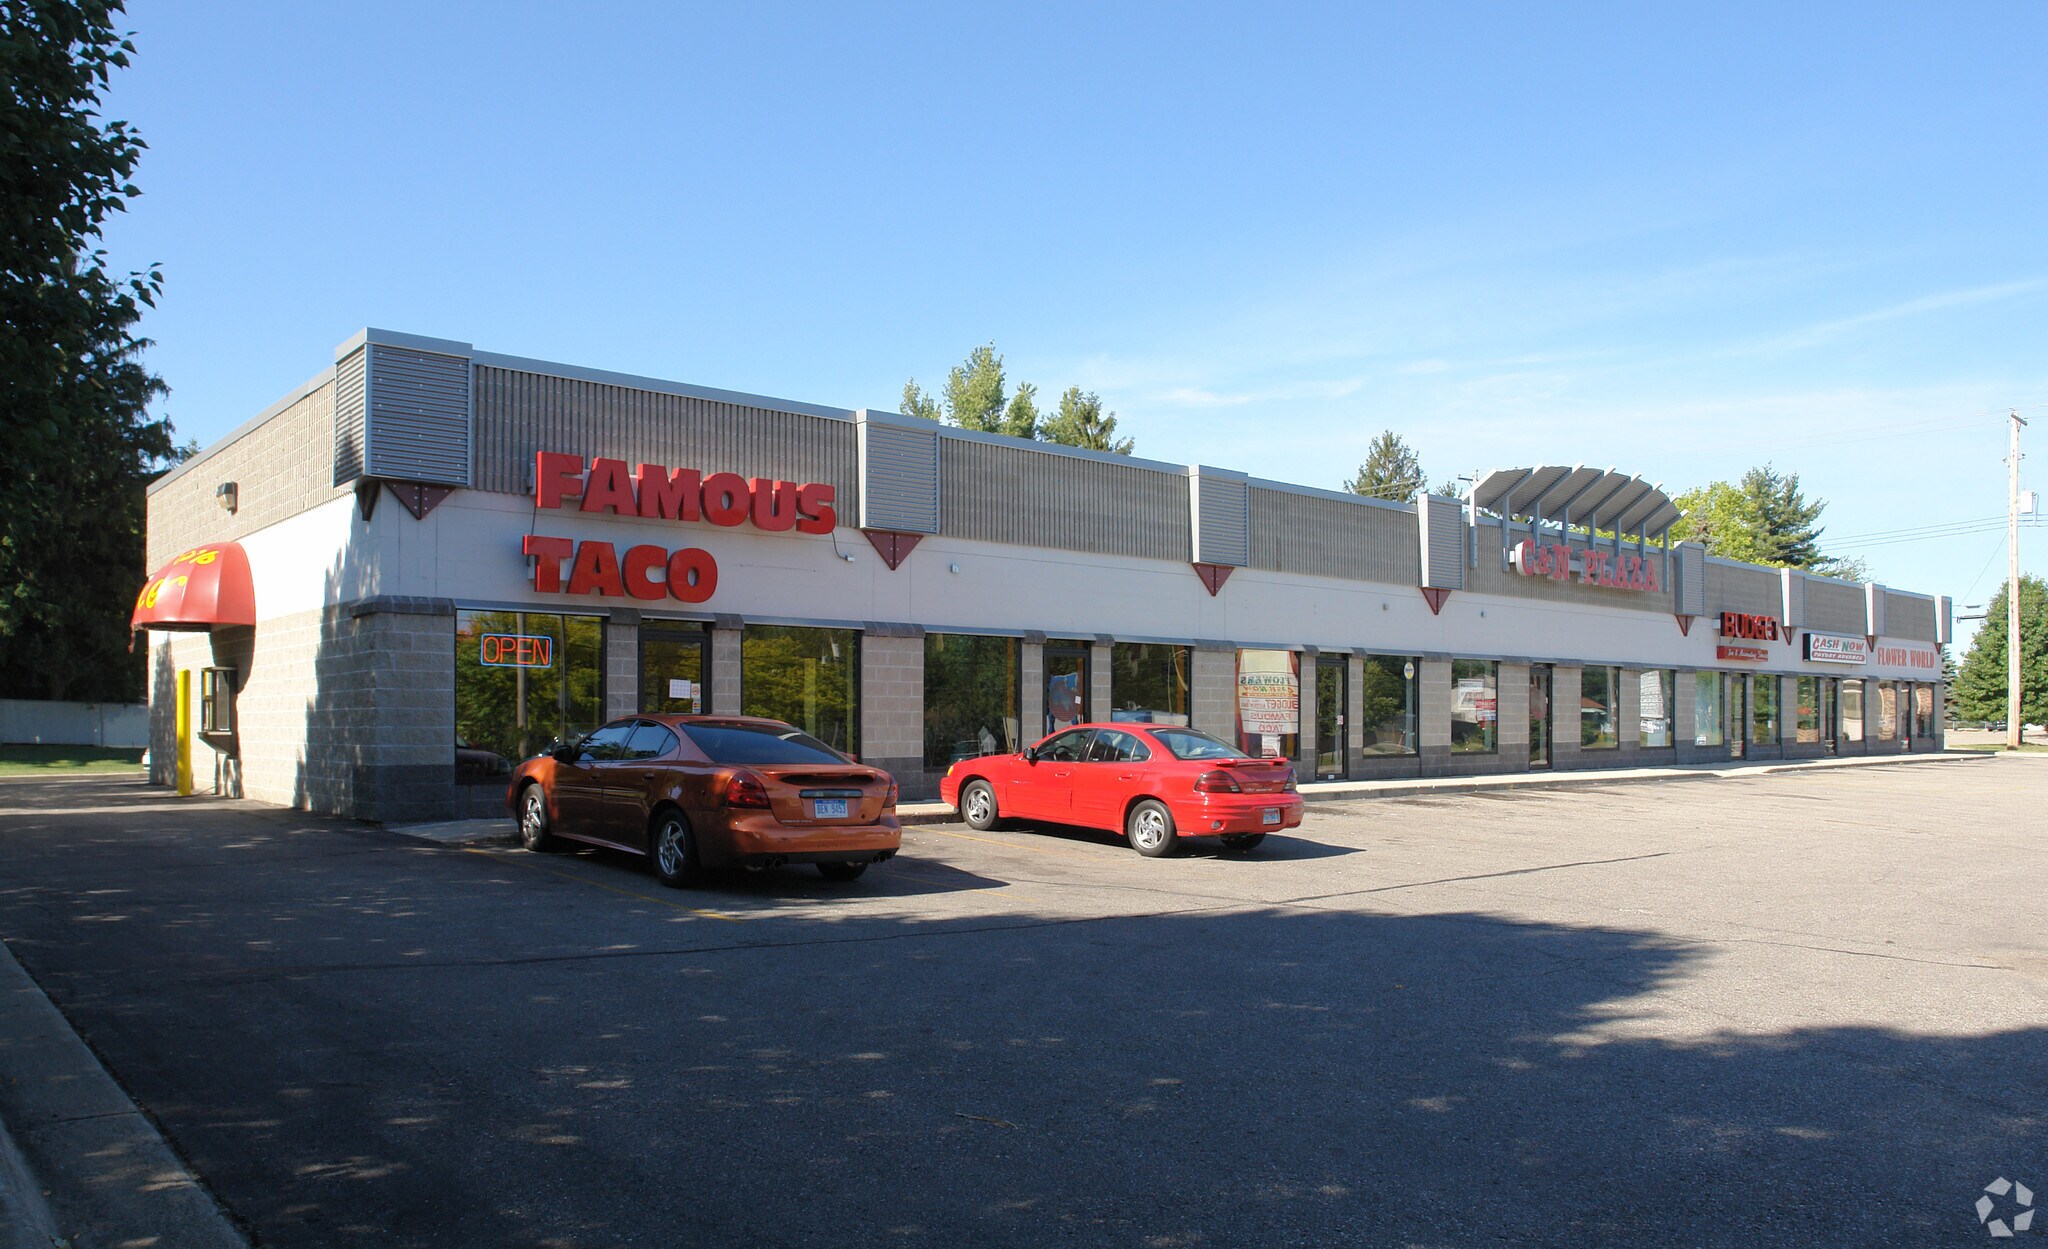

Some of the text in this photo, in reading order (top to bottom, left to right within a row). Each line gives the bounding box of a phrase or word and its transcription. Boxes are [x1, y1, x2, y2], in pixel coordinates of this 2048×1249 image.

[536, 451, 836, 535] FAMOUS
[522, 534, 718, 603] TACO
[1583, 549, 1659, 592] PLAZA
[483, 636, 550, 666] OPEN
[1812, 637, 1865, 651] CASH NOW
[1877, 647, 1935, 669] FLOWER WORLD
